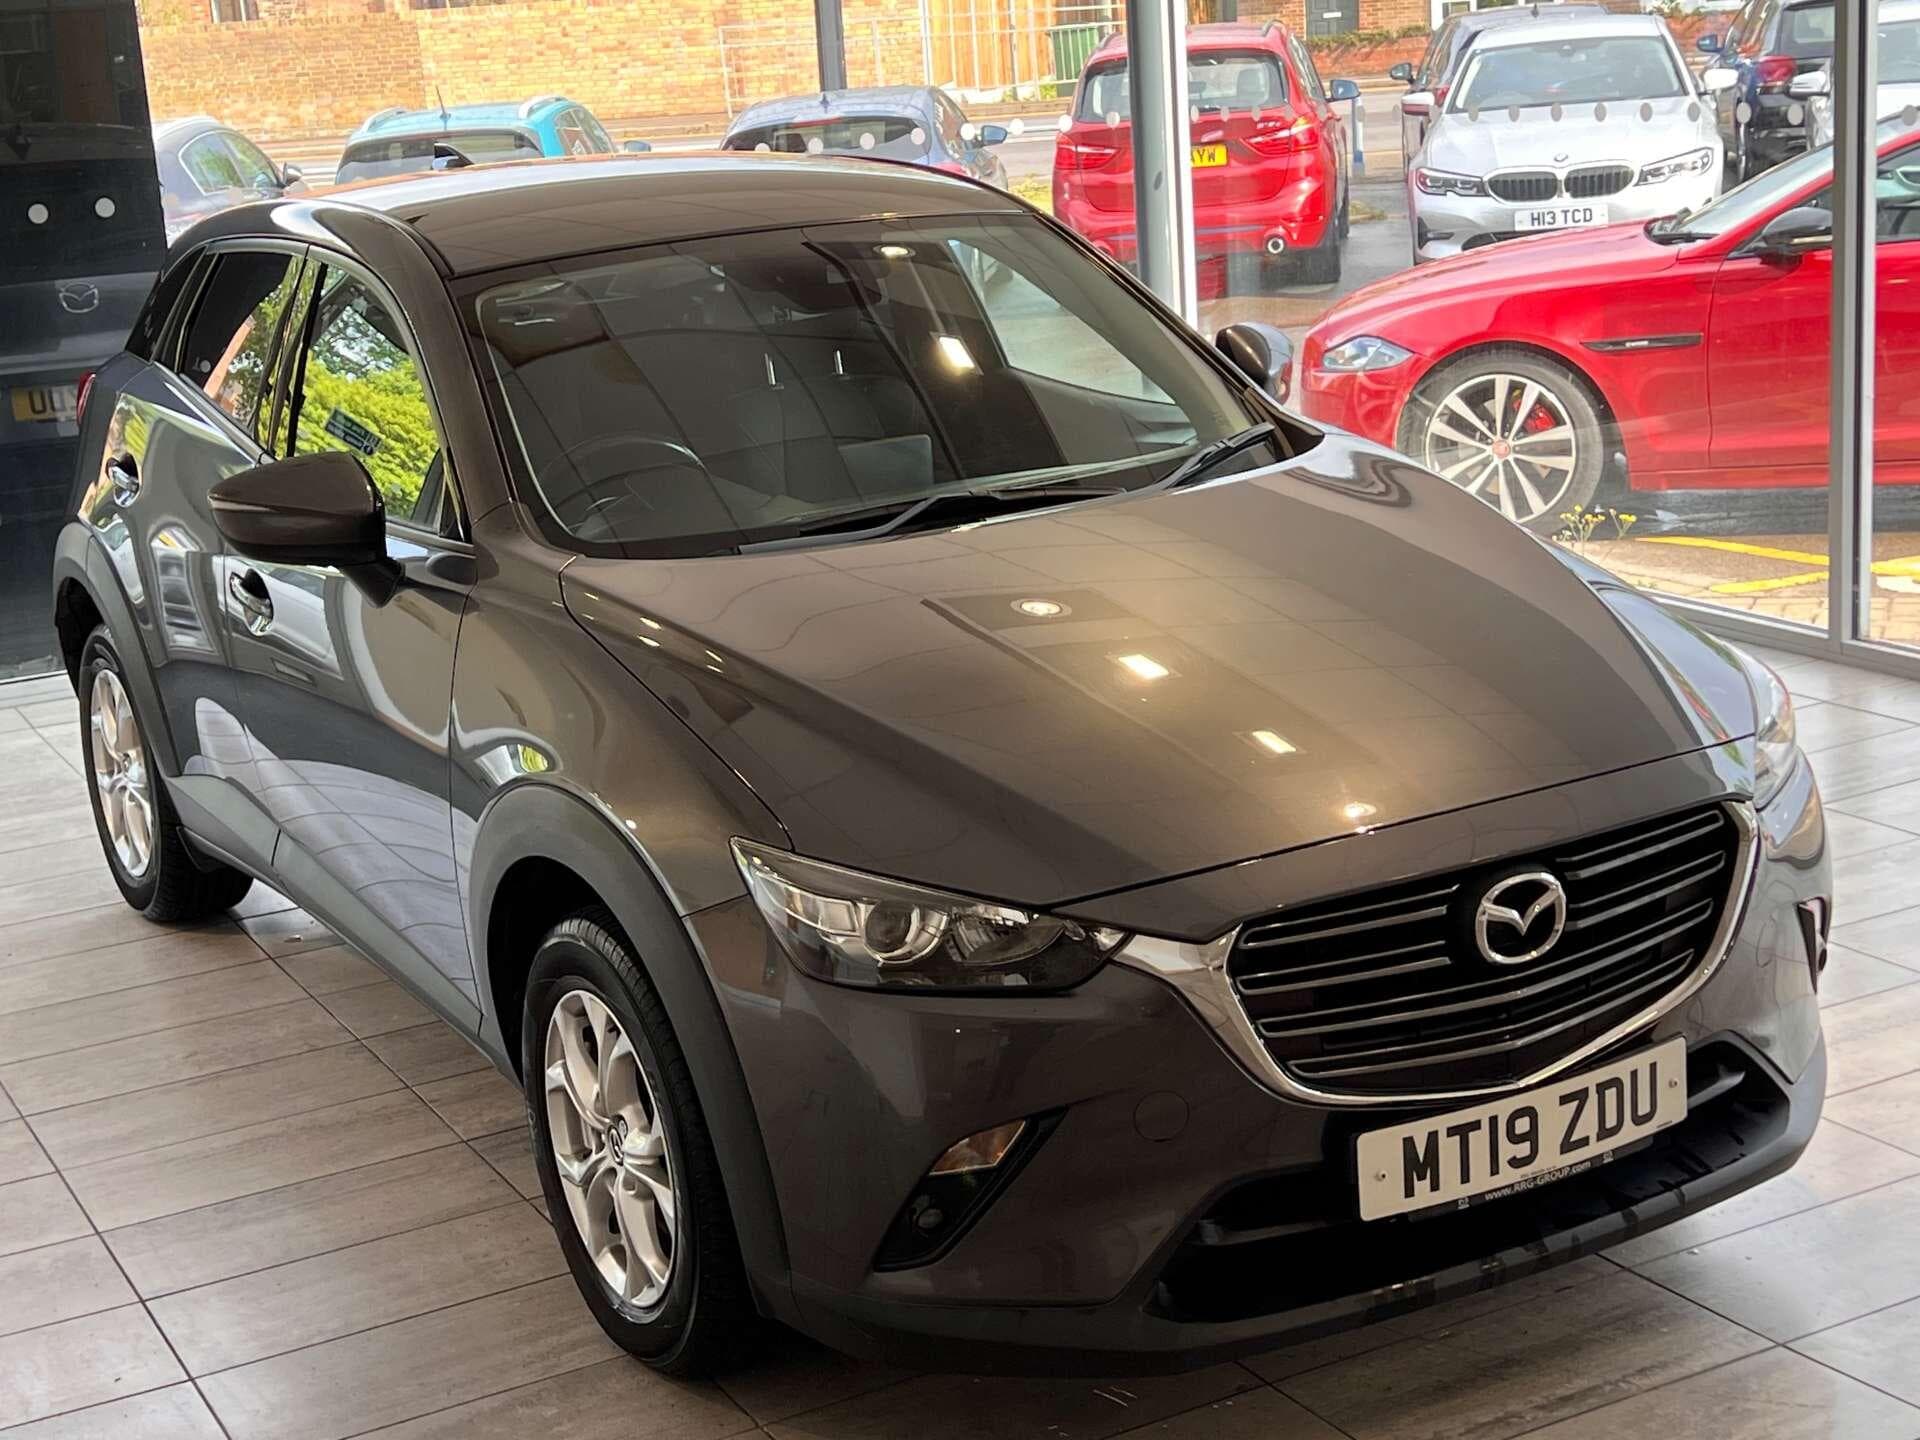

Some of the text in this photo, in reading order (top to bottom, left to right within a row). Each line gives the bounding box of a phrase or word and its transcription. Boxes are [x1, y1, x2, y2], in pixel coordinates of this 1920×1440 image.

[1531, 208, 1593, 227] H13 TCD
[1402, 1061, 1658, 1199] MT19 ZDU
